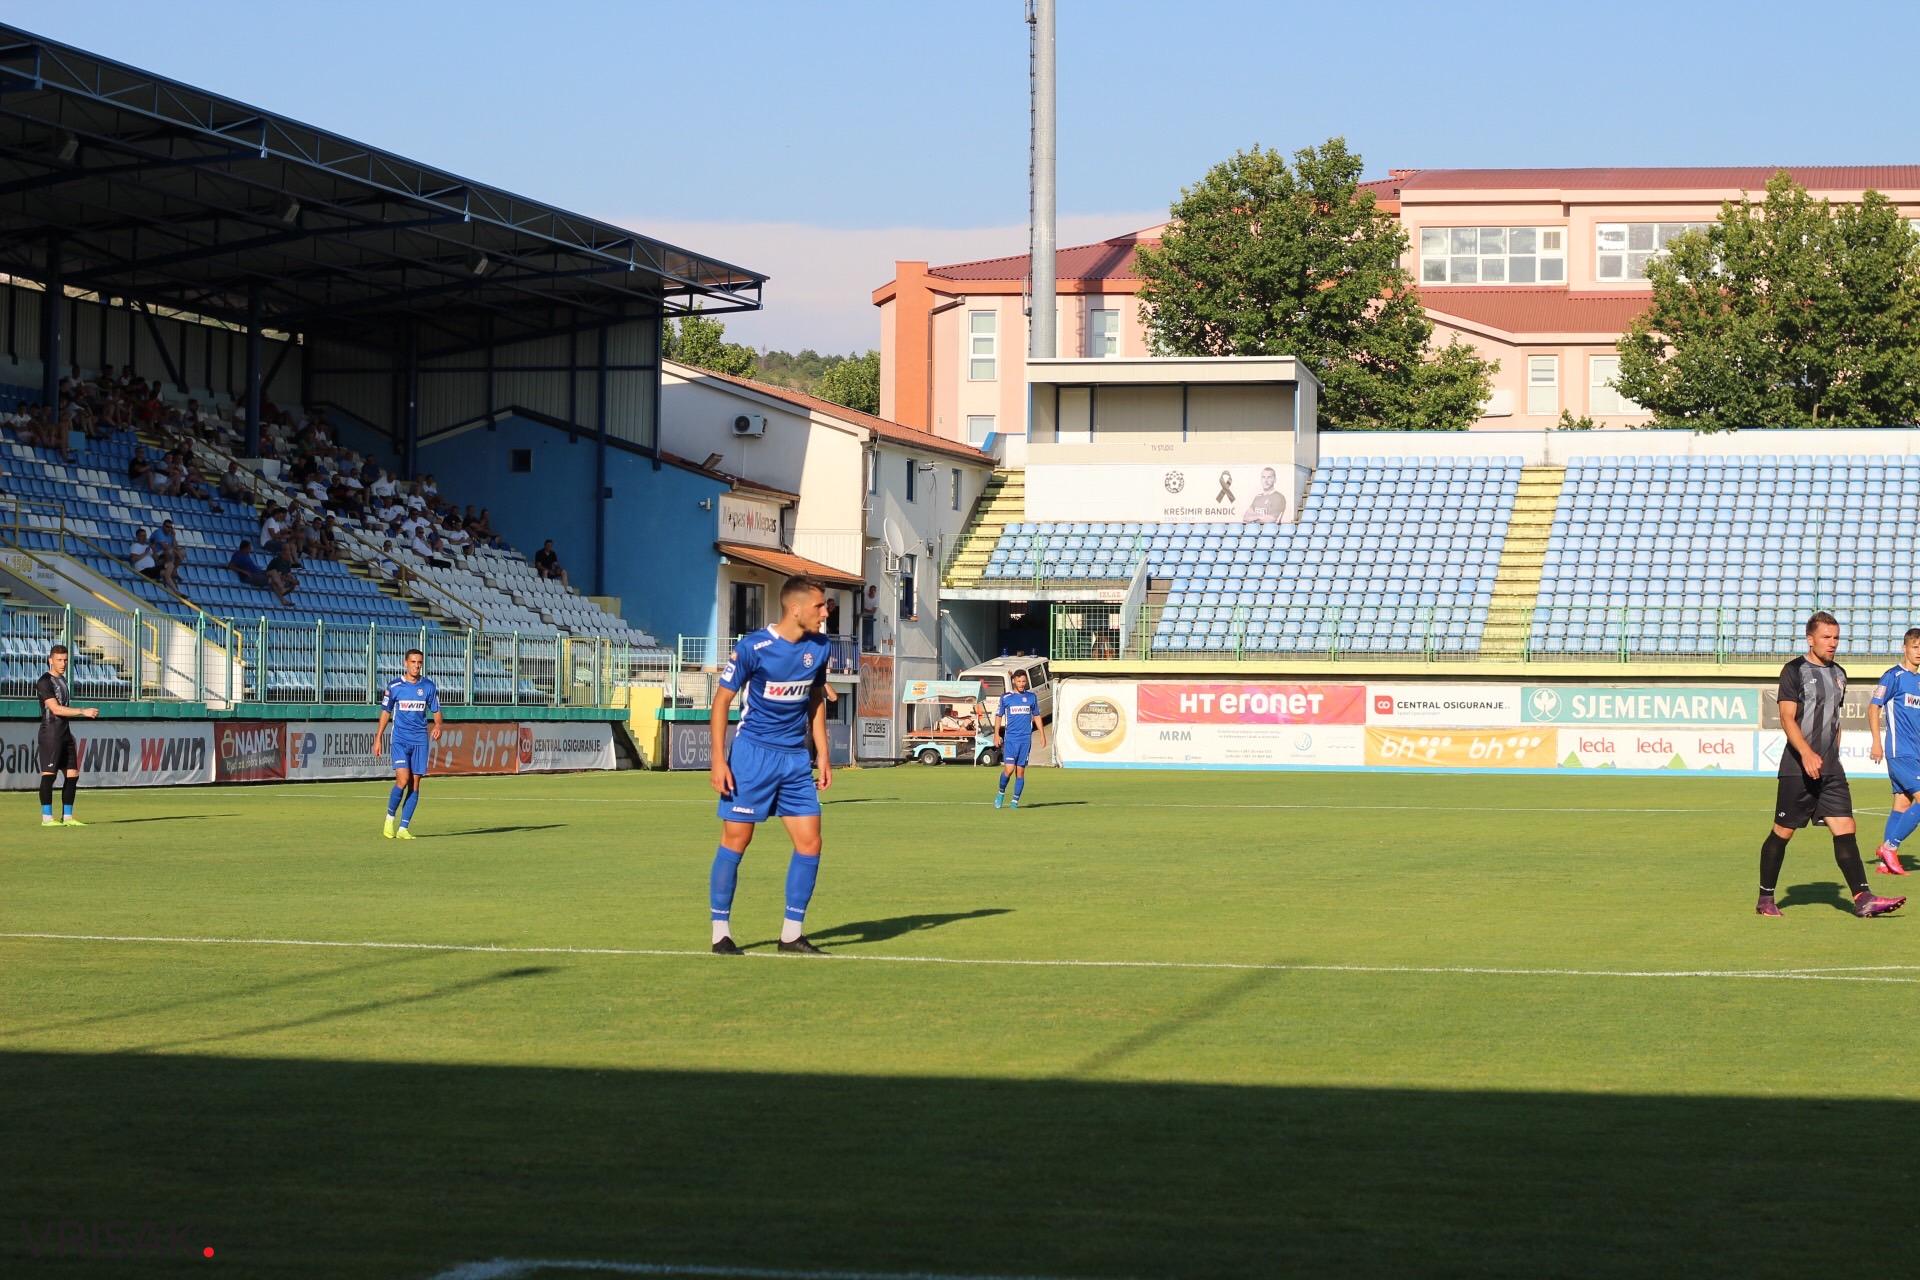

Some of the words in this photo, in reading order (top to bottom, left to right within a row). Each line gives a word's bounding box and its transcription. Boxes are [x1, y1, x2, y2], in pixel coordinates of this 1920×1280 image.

[1397, 701, 1440, 710] CENTRAL
[1443, 701, 1504, 710] OSIGURANJE
[1571, 694, 1748, 720] SJEMENARNA
[235, 727, 279, 757] NAMEX
[322, 733, 334, 755] JP
[1159, 731, 1192, 741] MRM
[534, 738, 562, 752] CENTRAL
[562, 739, 601, 753] OSIGURANJE
[1579, 737, 1615, 753] leda
[1637, 738, 1673, 754] leda
[1698, 738, 1735, 755] leda
